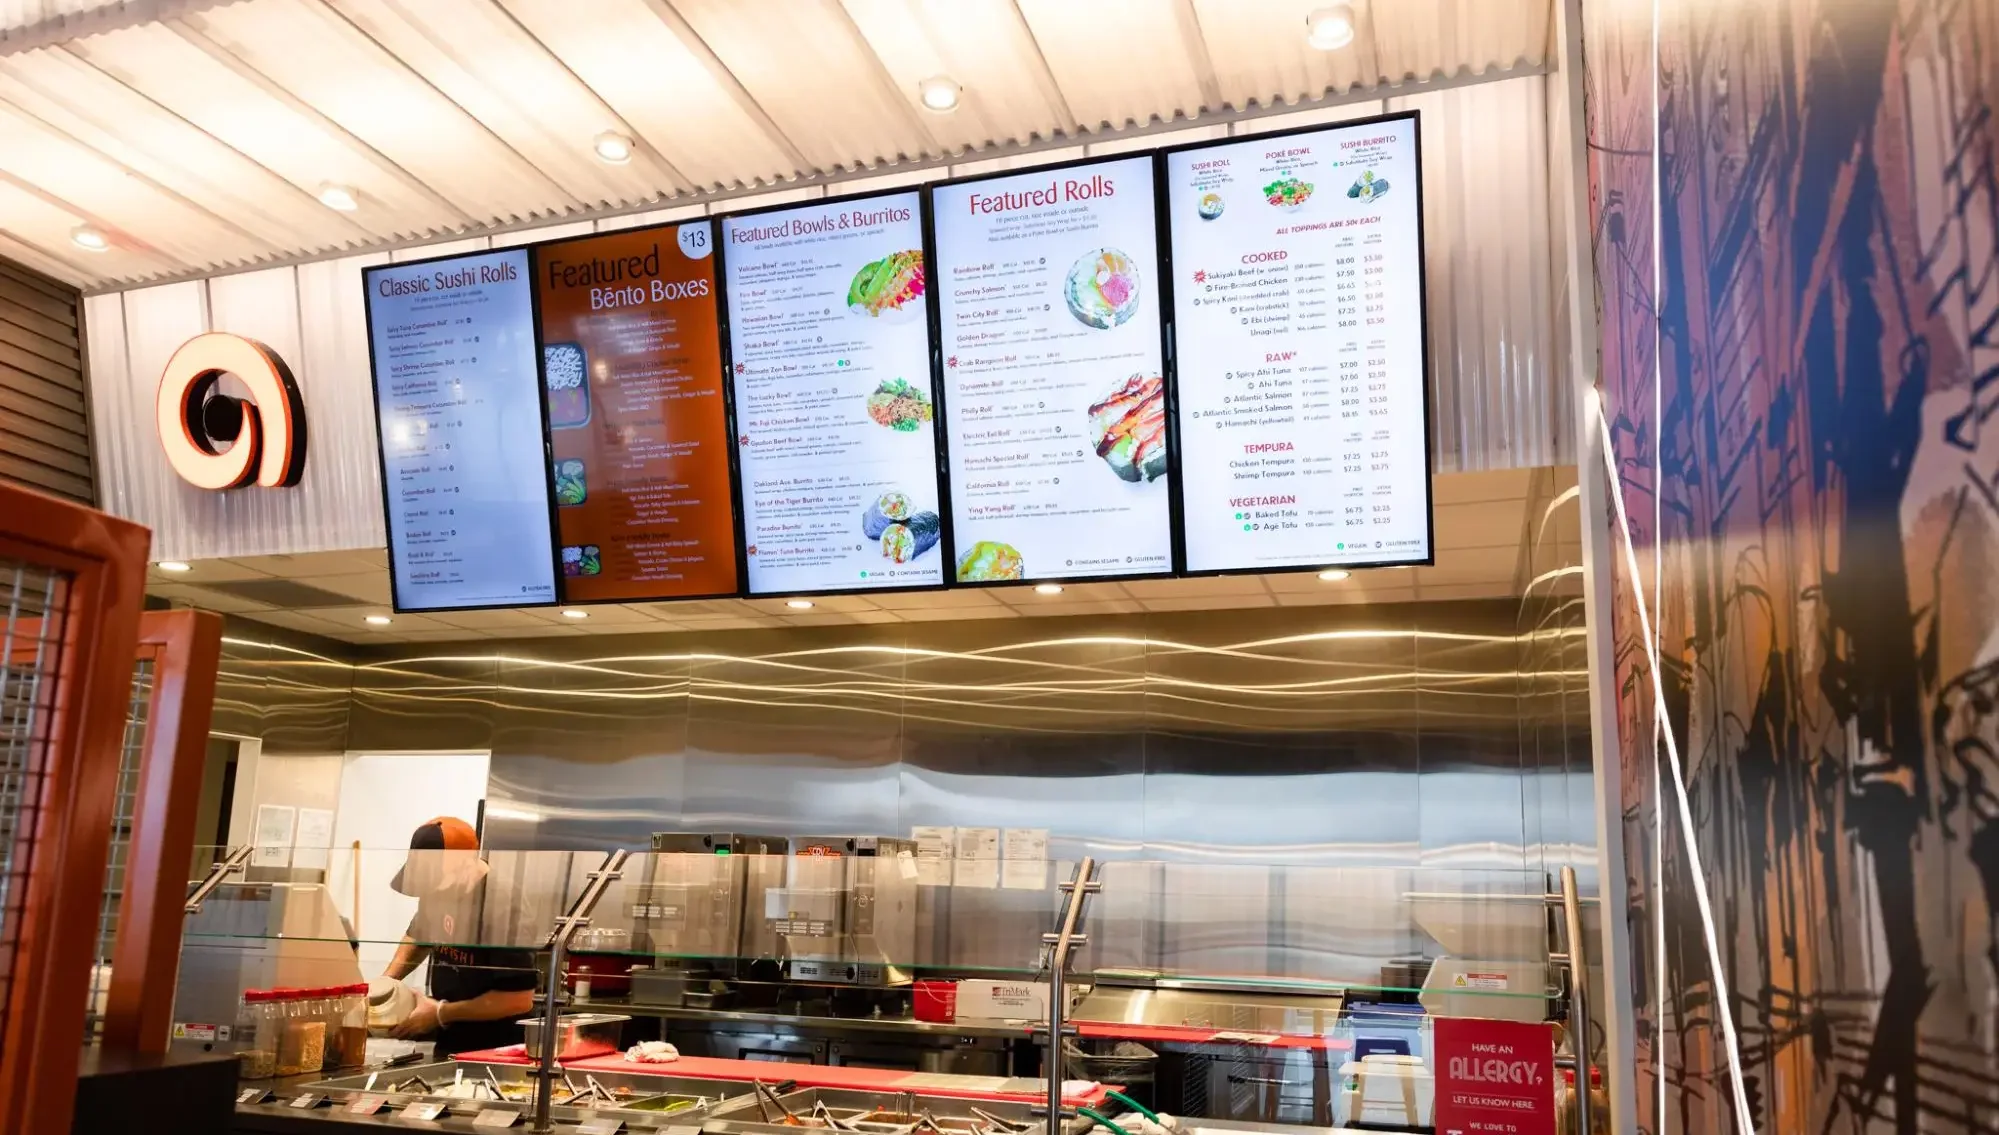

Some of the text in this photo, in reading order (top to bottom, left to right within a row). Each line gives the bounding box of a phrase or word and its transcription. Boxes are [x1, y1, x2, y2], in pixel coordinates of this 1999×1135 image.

[1340, 135, 1396, 150] SUSHI BURRITO
[1288, 148, 1311, 156] BOWL
[1213, 159, 1230, 167] ROLL
[970, 175, 1114, 215] Featured Rolls
[732, 220, 788, 244] Featured
[792, 215, 835, 236] Bowls
[838, 213, 850, 229] &
[853, 207, 910, 227] Burritos
[1291, 223, 1327, 233] TOPPINGS
[1329, 220, 1343, 228] ARE
[1360, 216, 1380, 224] EACH
[682, 231, 705, 247] $13
[1242, 251, 1288, 264] COOKED
[549, 244, 660, 290] Featured
[380, 262, 517, 297] Classic Sushi Rolls
[1208, 268, 1255, 280] Sukiyaki Beef
[651, 279, 709, 302] Boxes
[1225, 419, 1257, 427] Hamachi
[1244, 442, 1294, 453] TEMPURA
[1344, 453, 1360, 461] $7.25
[1230, 495, 1295, 507] VEGETARIAN
[968, 506, 982, 514] Ying
[1264, 523, 1279, 531] Age
[1002, 987, 1030, 996] TriMark
[1472, 1043, 1513, 1054] HAVE AN
[1449, 1056, 1543, 1085] ALLERGY?
[1482, 1098, 1510, 1107] KNOW
[1512, 1101, 1535, 1109] HERE.
[1470, 1121, 1481, 1129] WE
[1484, 1123, 1504, 1132] LOVE
